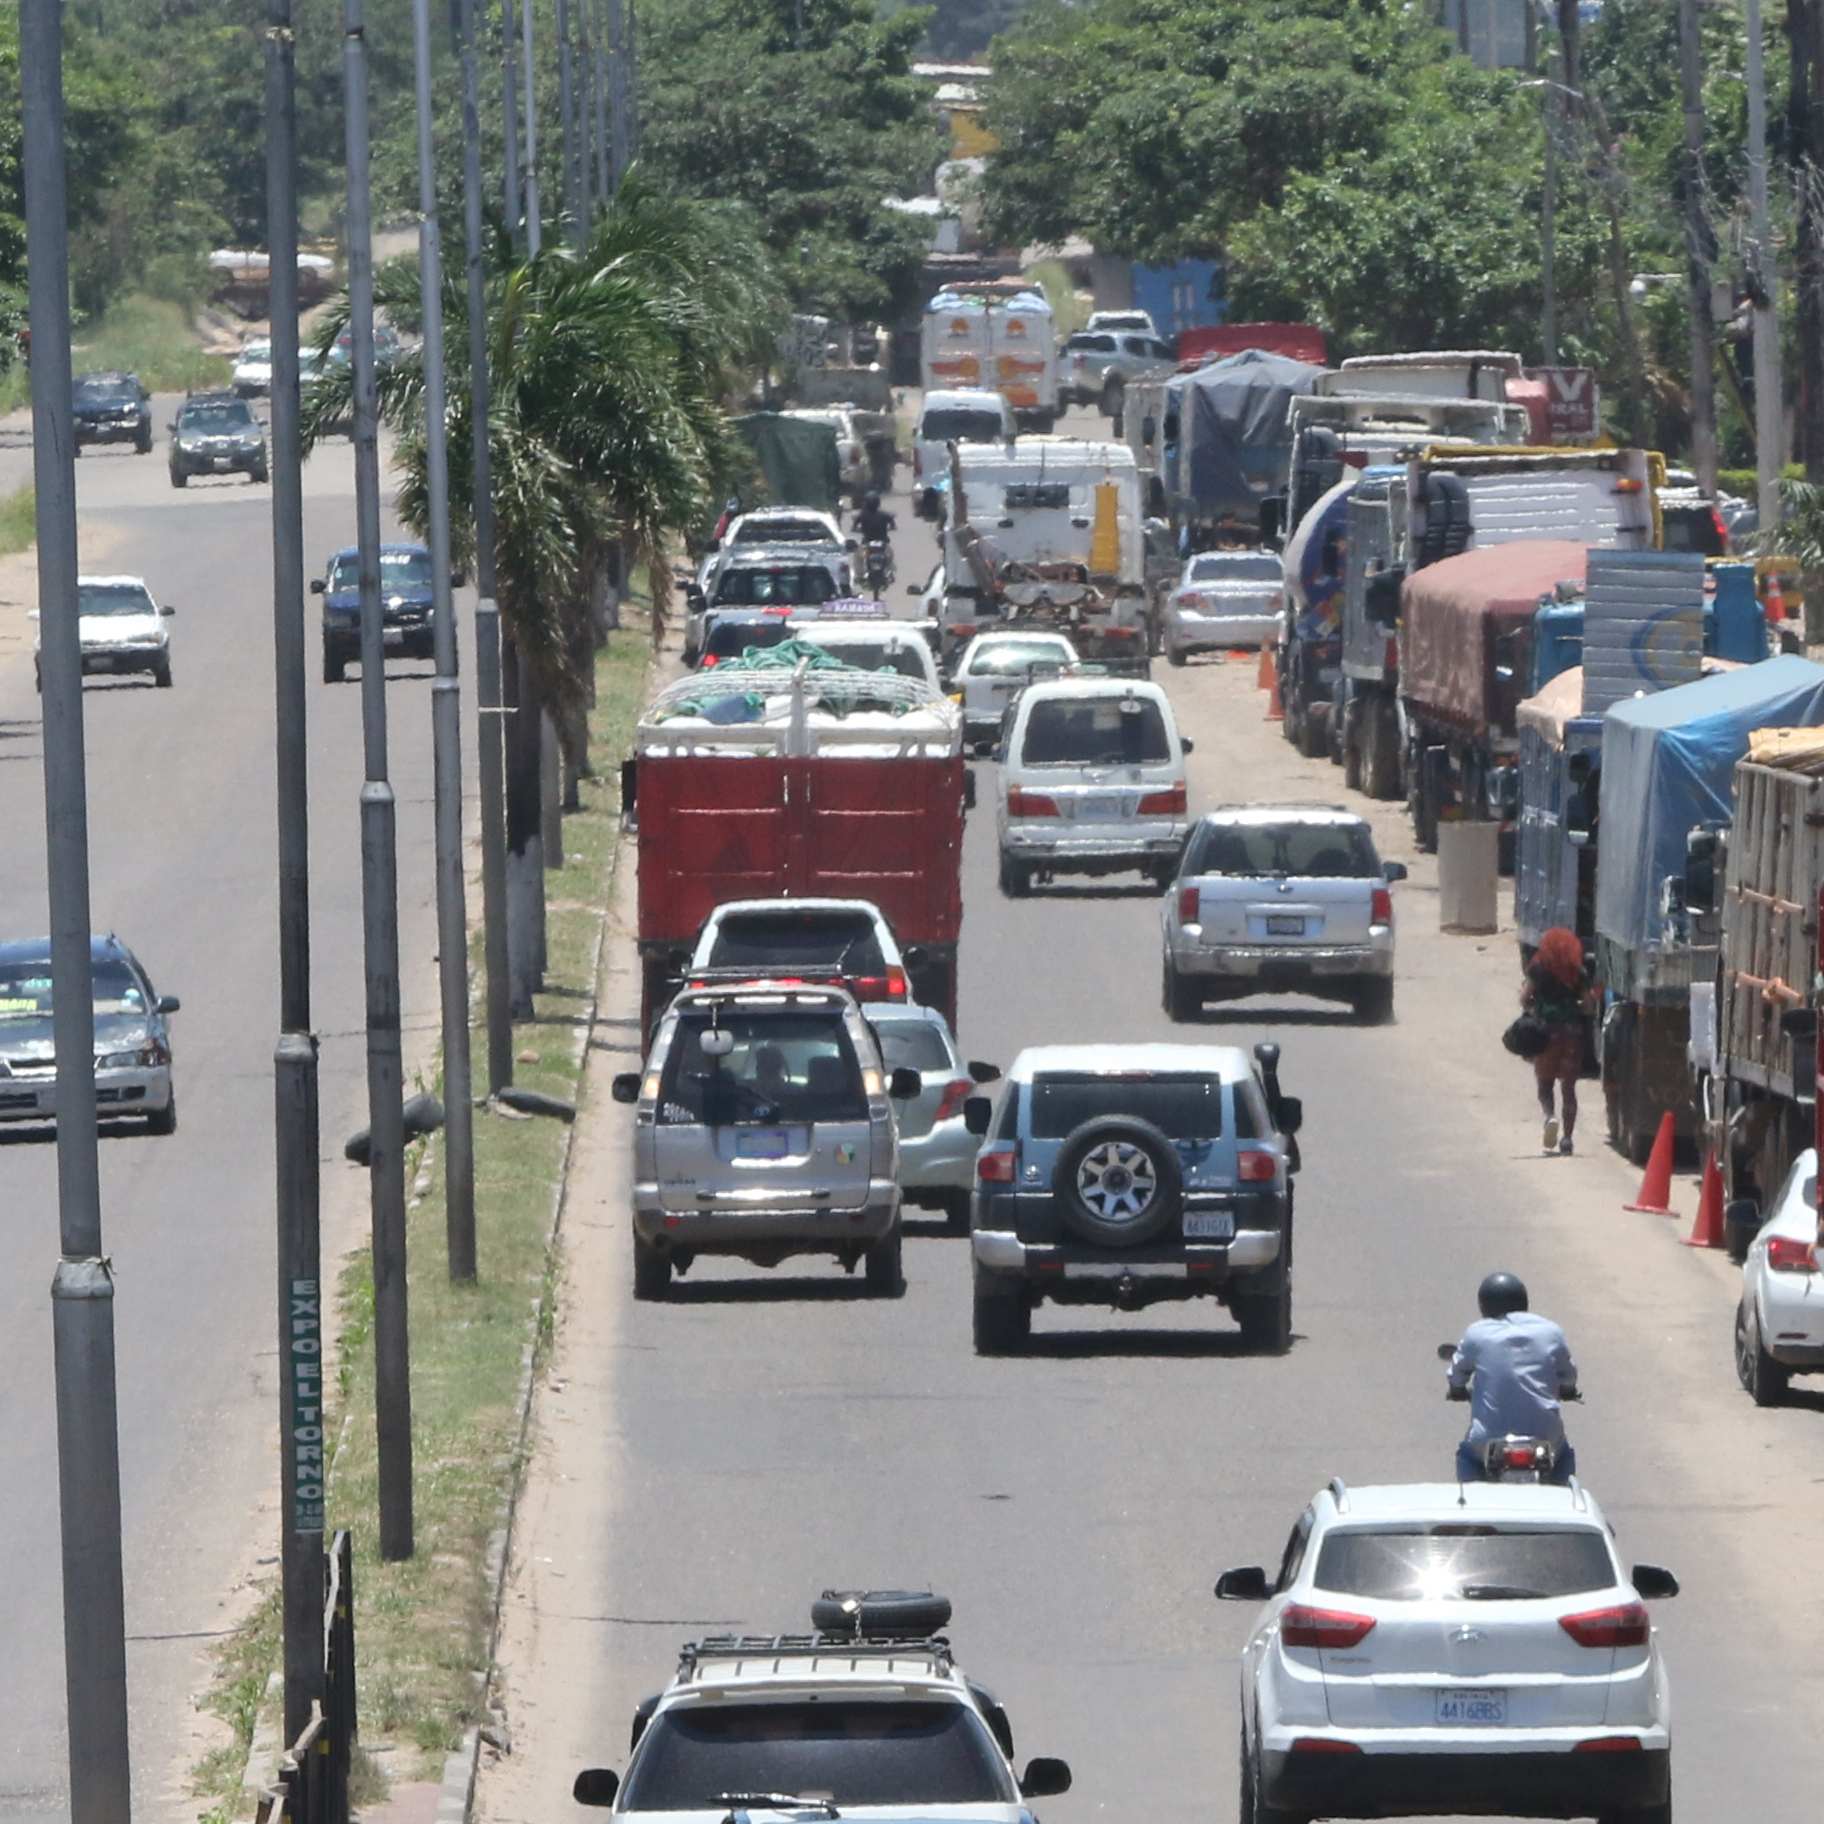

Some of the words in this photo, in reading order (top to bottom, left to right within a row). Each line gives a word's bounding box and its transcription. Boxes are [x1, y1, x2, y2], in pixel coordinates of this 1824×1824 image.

[291, 1280, 320, 1354] EXPO
[296, 1363, 320, 1397] EL
[294, 1406, 322, 1499] TORNO
